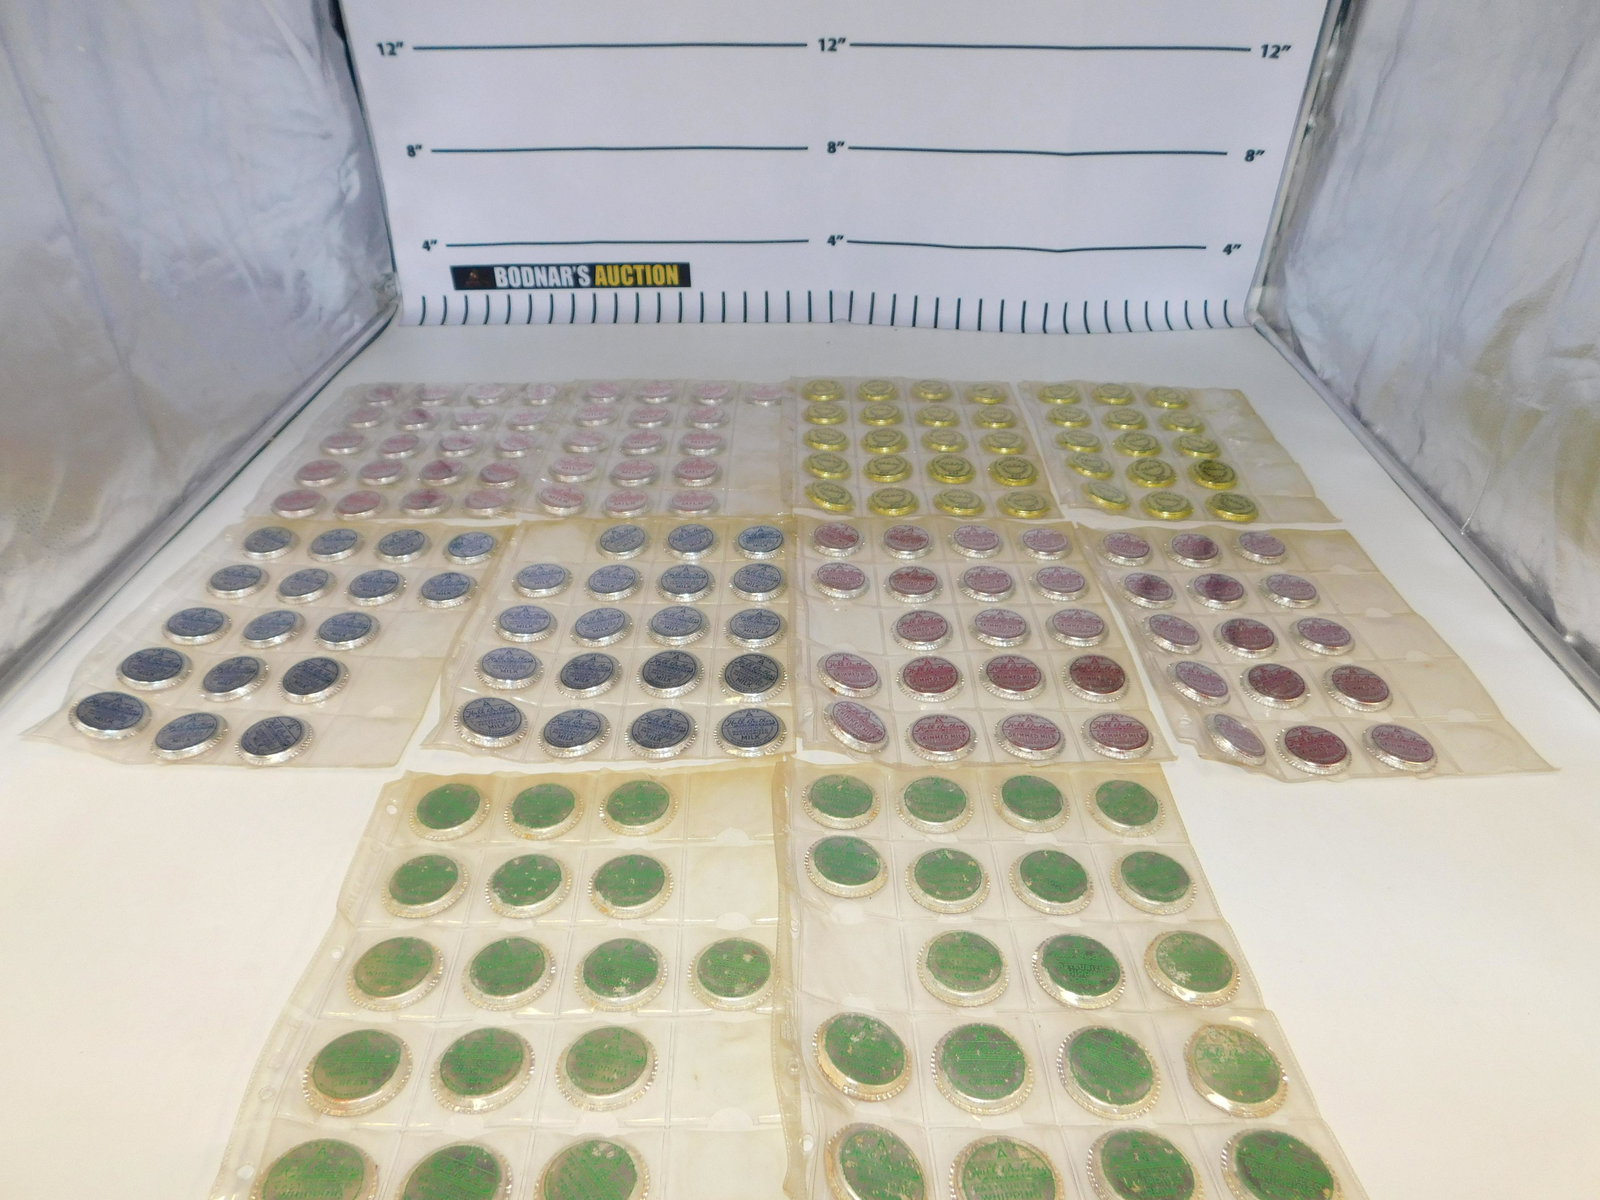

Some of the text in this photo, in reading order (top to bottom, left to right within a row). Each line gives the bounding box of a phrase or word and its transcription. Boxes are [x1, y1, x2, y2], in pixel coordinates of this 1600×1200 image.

[375, 40, 405, 57] 12"
[817, 36, 847, 53] 12"
[1260, 43, 1293, 60] 12"
[406, 143, 423, 159] 8"
[826, 140, 846, 155] 8"
[1243, 148, 1266, 163] 8"
[421, 238, 438, 252] 4"
[826, 234, 845, 247] 4"
[1222, 243, 1242, 256] 4"
[493, 263, 679, 288] BODNAR'S AUCTION
